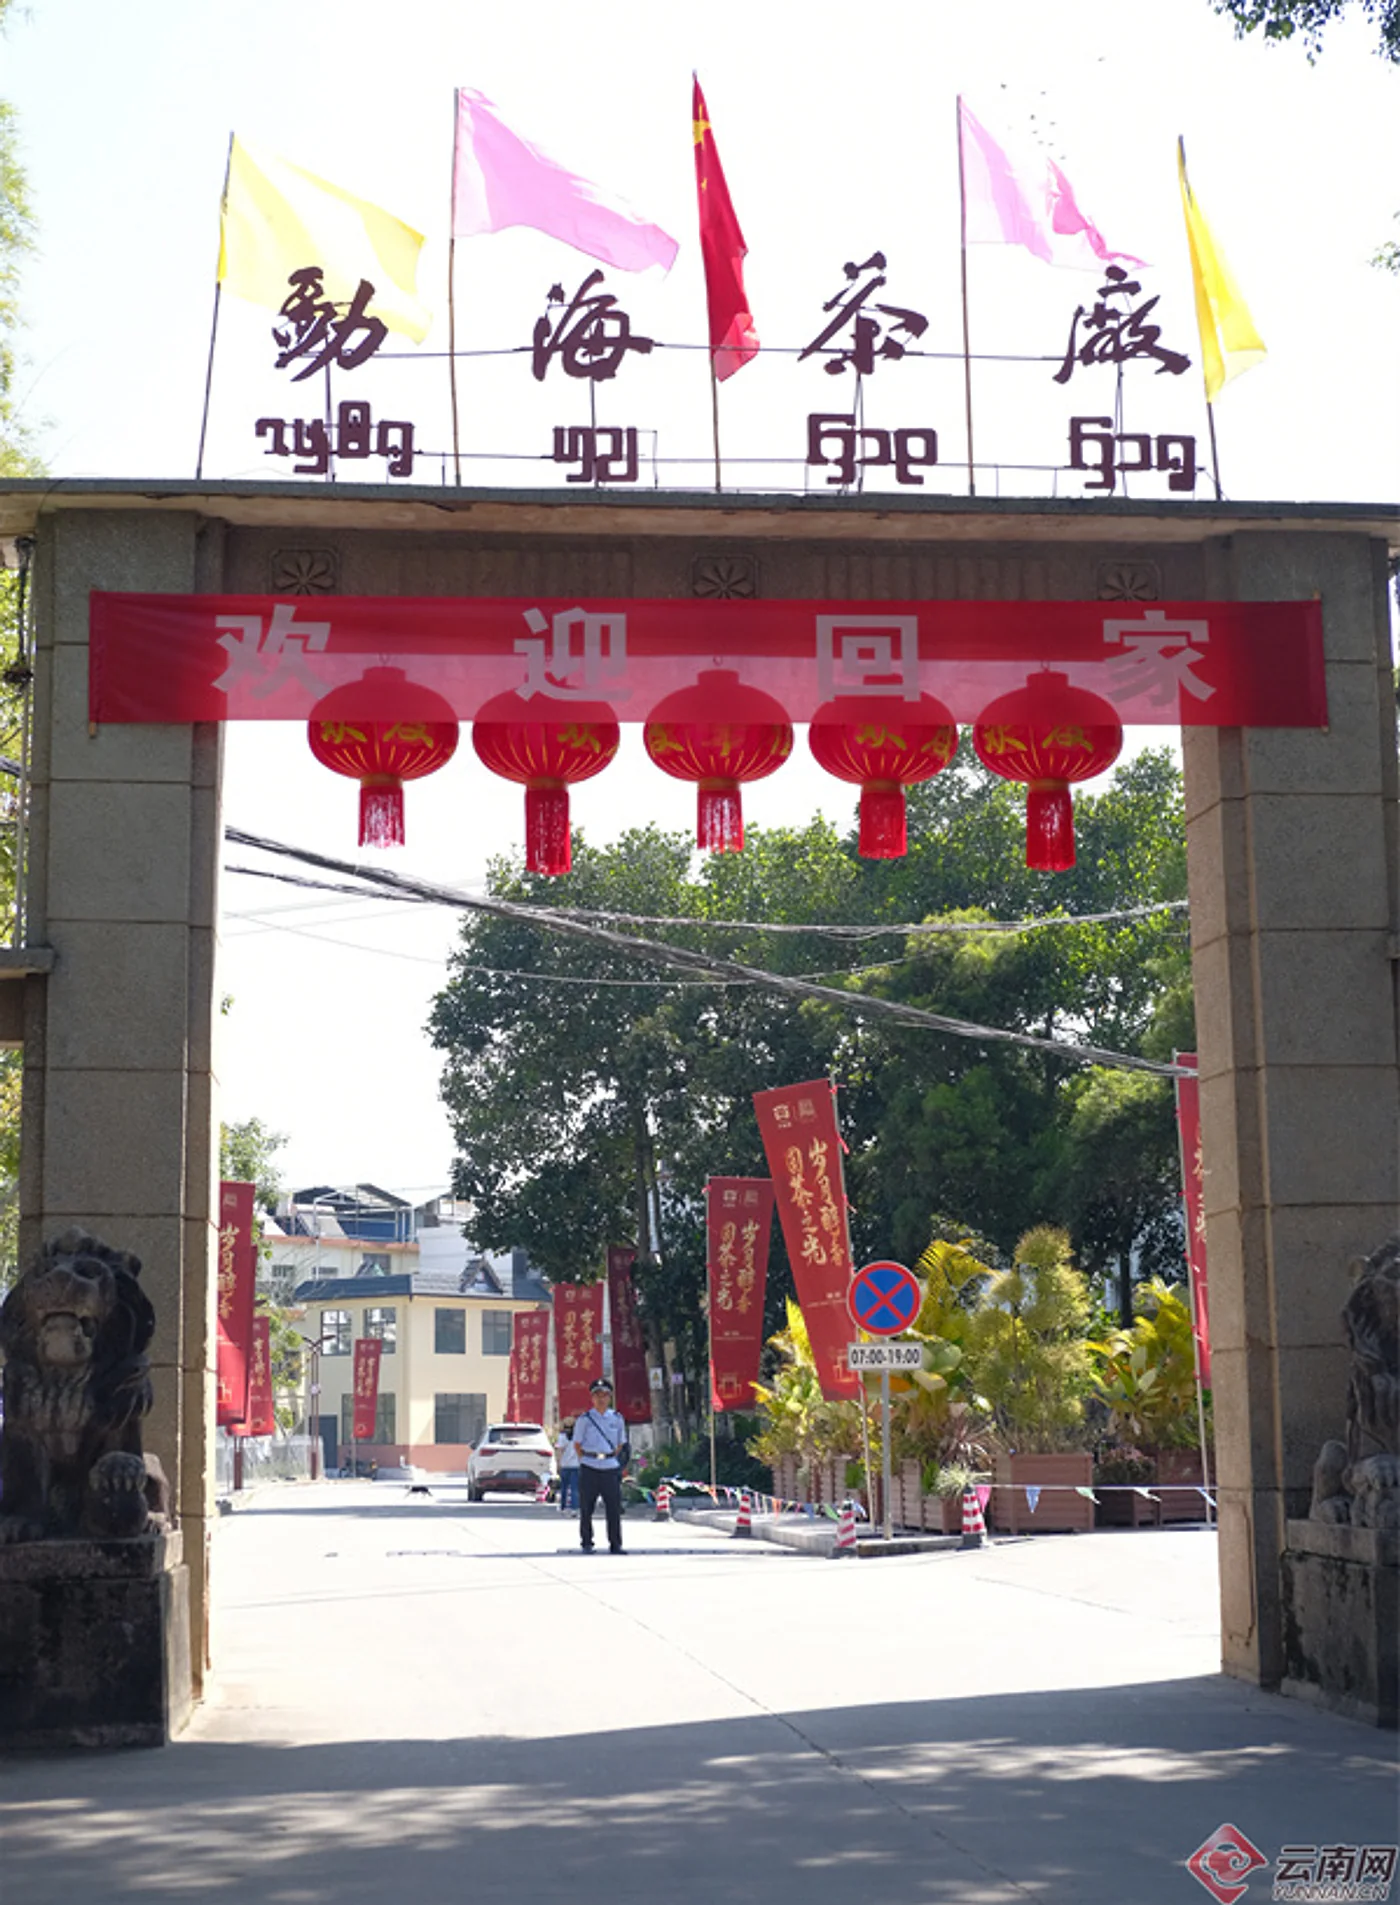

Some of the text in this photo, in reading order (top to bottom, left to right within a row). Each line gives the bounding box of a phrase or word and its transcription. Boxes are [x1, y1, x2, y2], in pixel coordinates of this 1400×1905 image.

[210, 603, 1218, 702] 欢迎回家
[851, 1347, 920, 1364] 07:00-19:00
